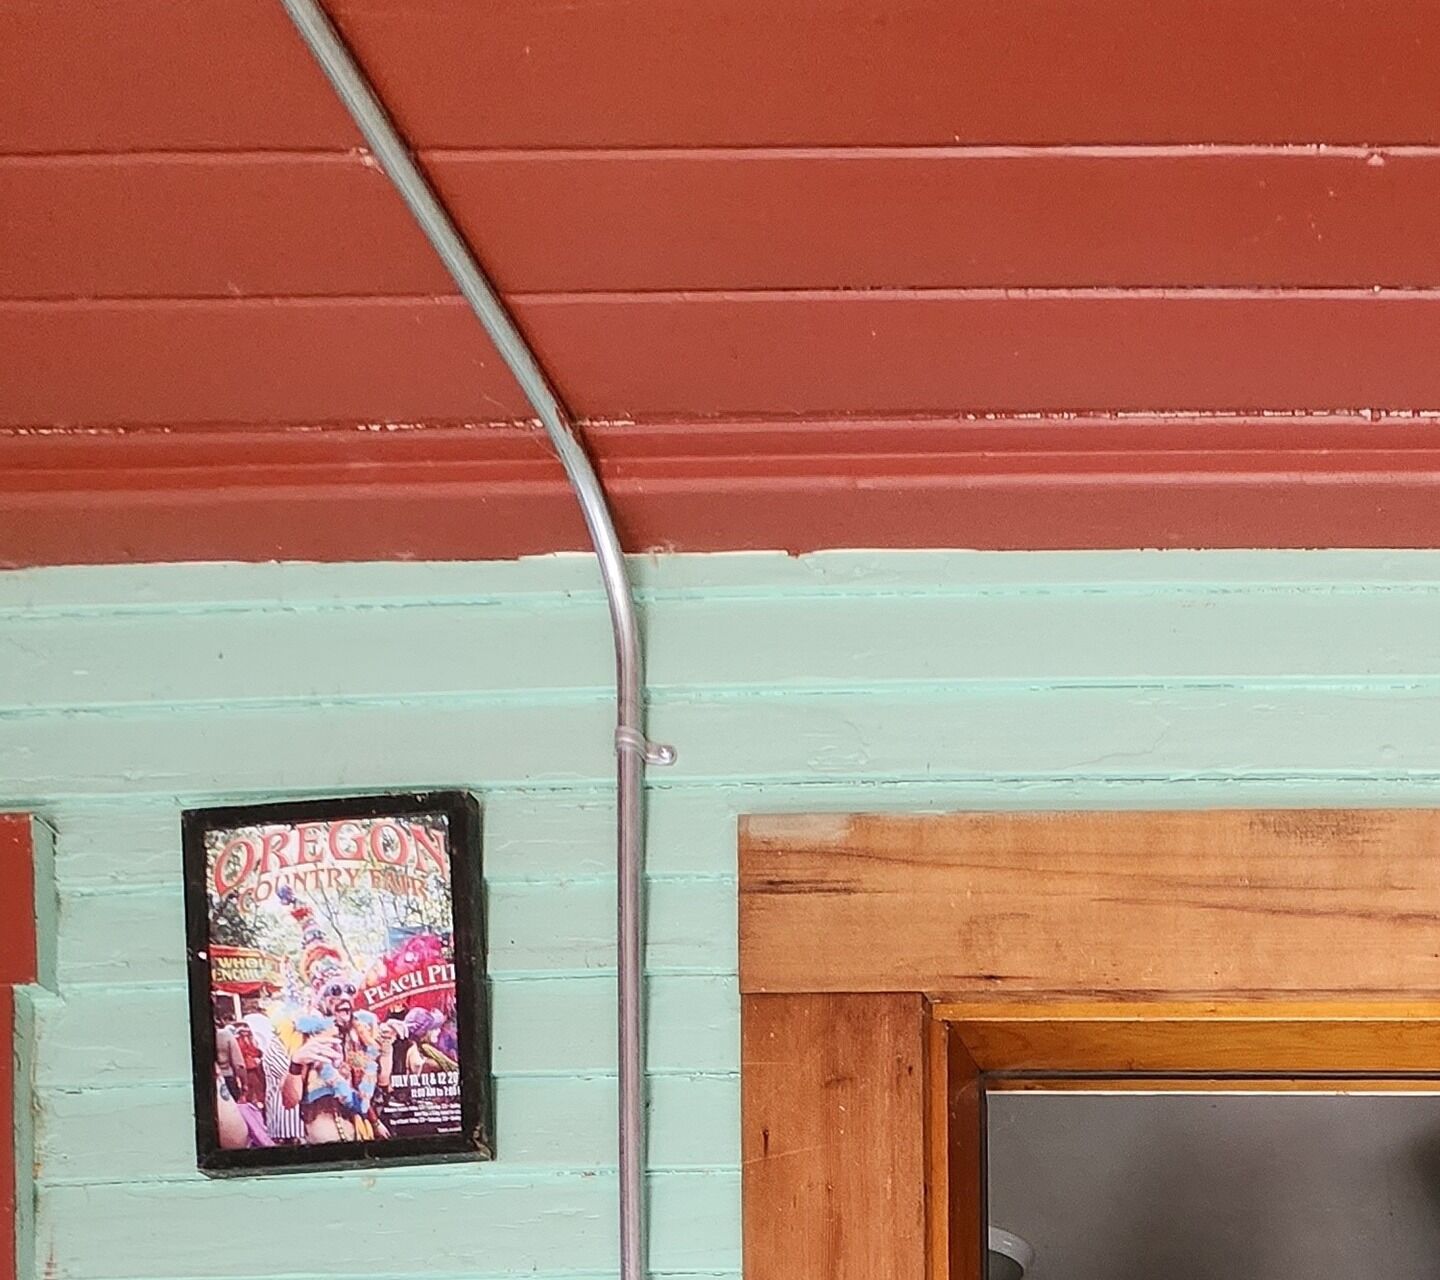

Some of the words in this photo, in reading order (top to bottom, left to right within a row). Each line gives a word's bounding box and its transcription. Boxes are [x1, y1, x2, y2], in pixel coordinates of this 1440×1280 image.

[213, 818, 448, 897] OREGON
[238, 867, 361, 913] COUNTRY
[370, 869, 429, 900] FAIR
[363, 970, 425, 1005] PEACH
